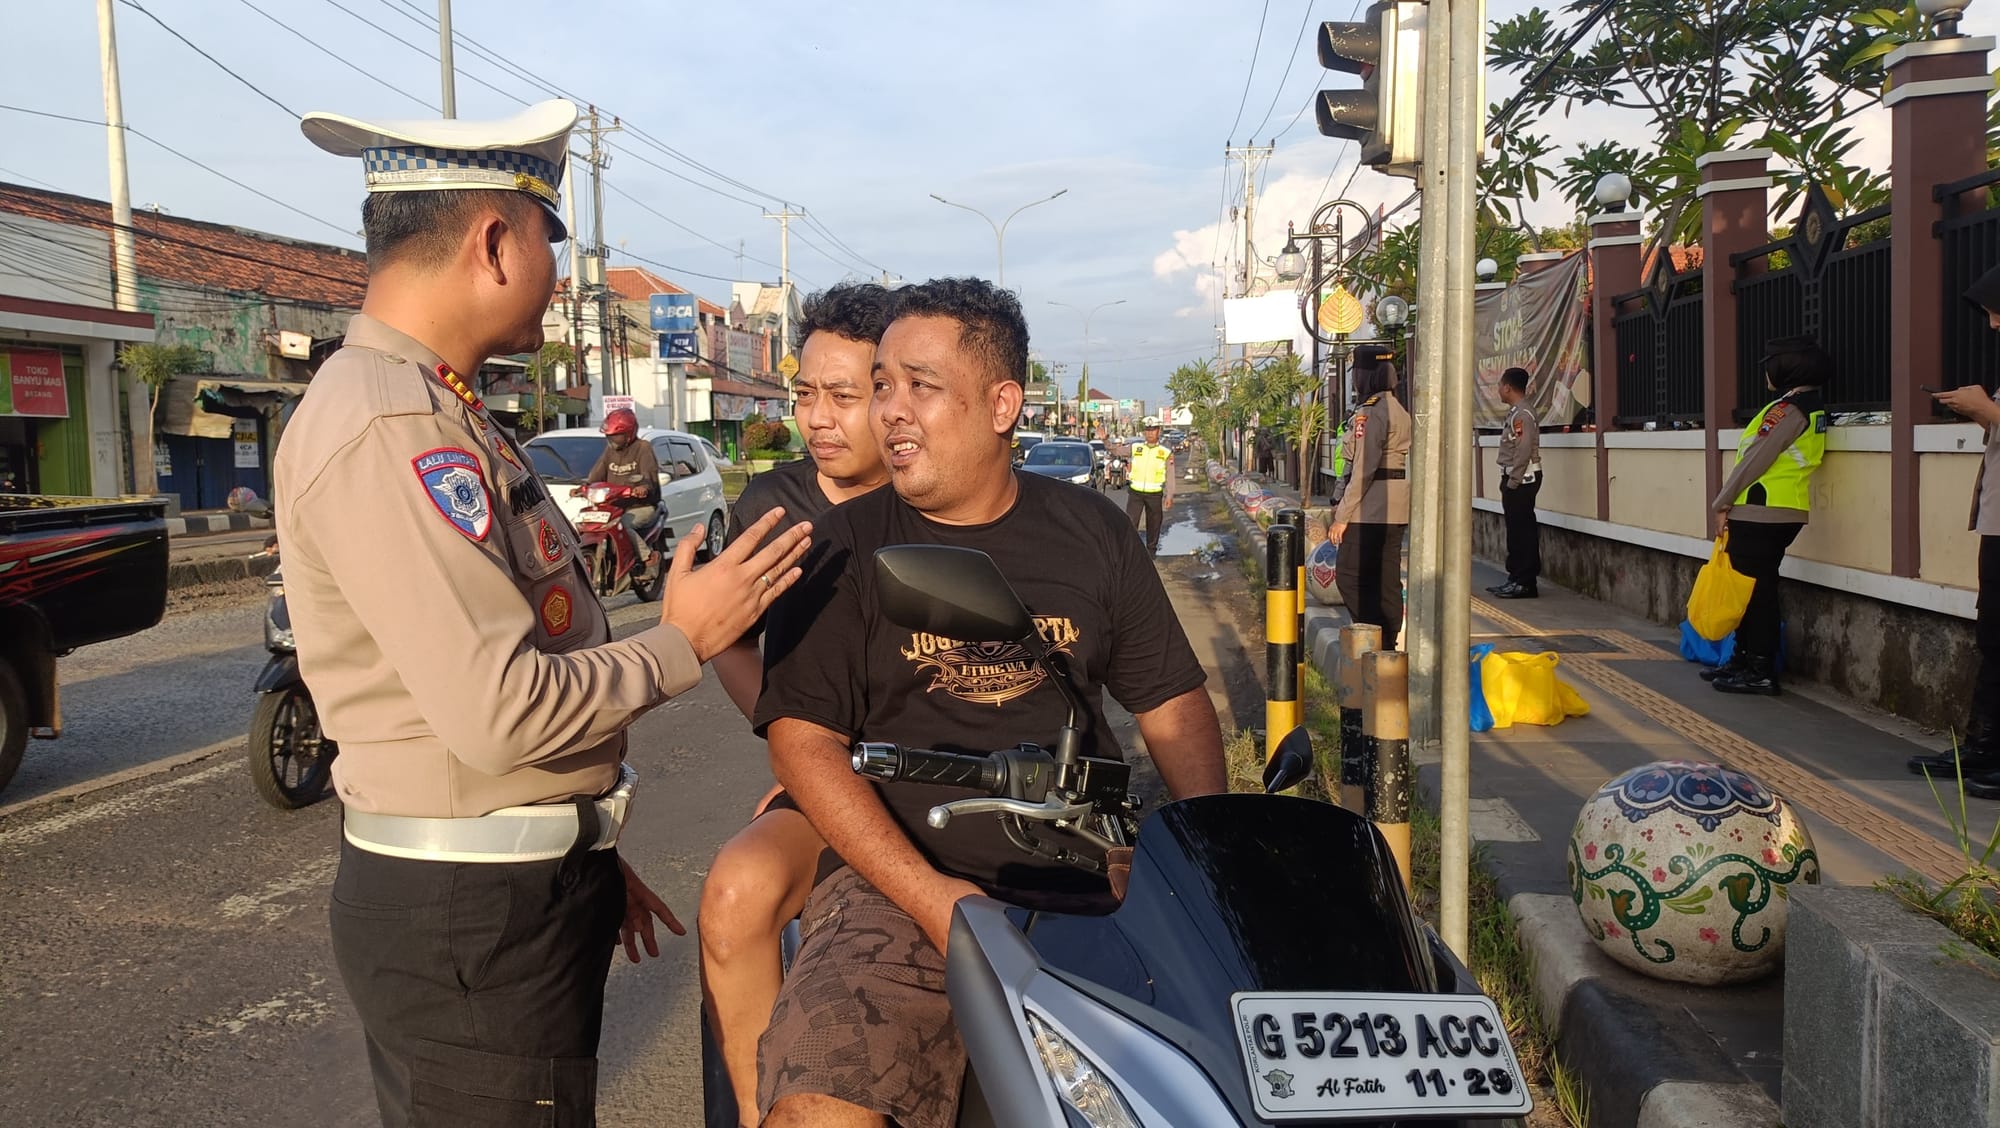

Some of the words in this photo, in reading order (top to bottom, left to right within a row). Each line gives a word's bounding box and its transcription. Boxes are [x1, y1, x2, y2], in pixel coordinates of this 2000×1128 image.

[666, 306, 694, 318] BCA
[26, 366, 48, 375] TOKO
[13, 375, 41, 386] BANYU
[43, 377, 62, 387] MAS
[418, 451, 445, 470] LALU
[1252, 1012, 1287, 1059] G
[1291, 1012, 1408, 1058] 5213
[1414, 1013, 1500, 1059] ACC
[1316, 1078, 1340, 1098] Al
[1343, 1077, 1386, 1095] Fatih
